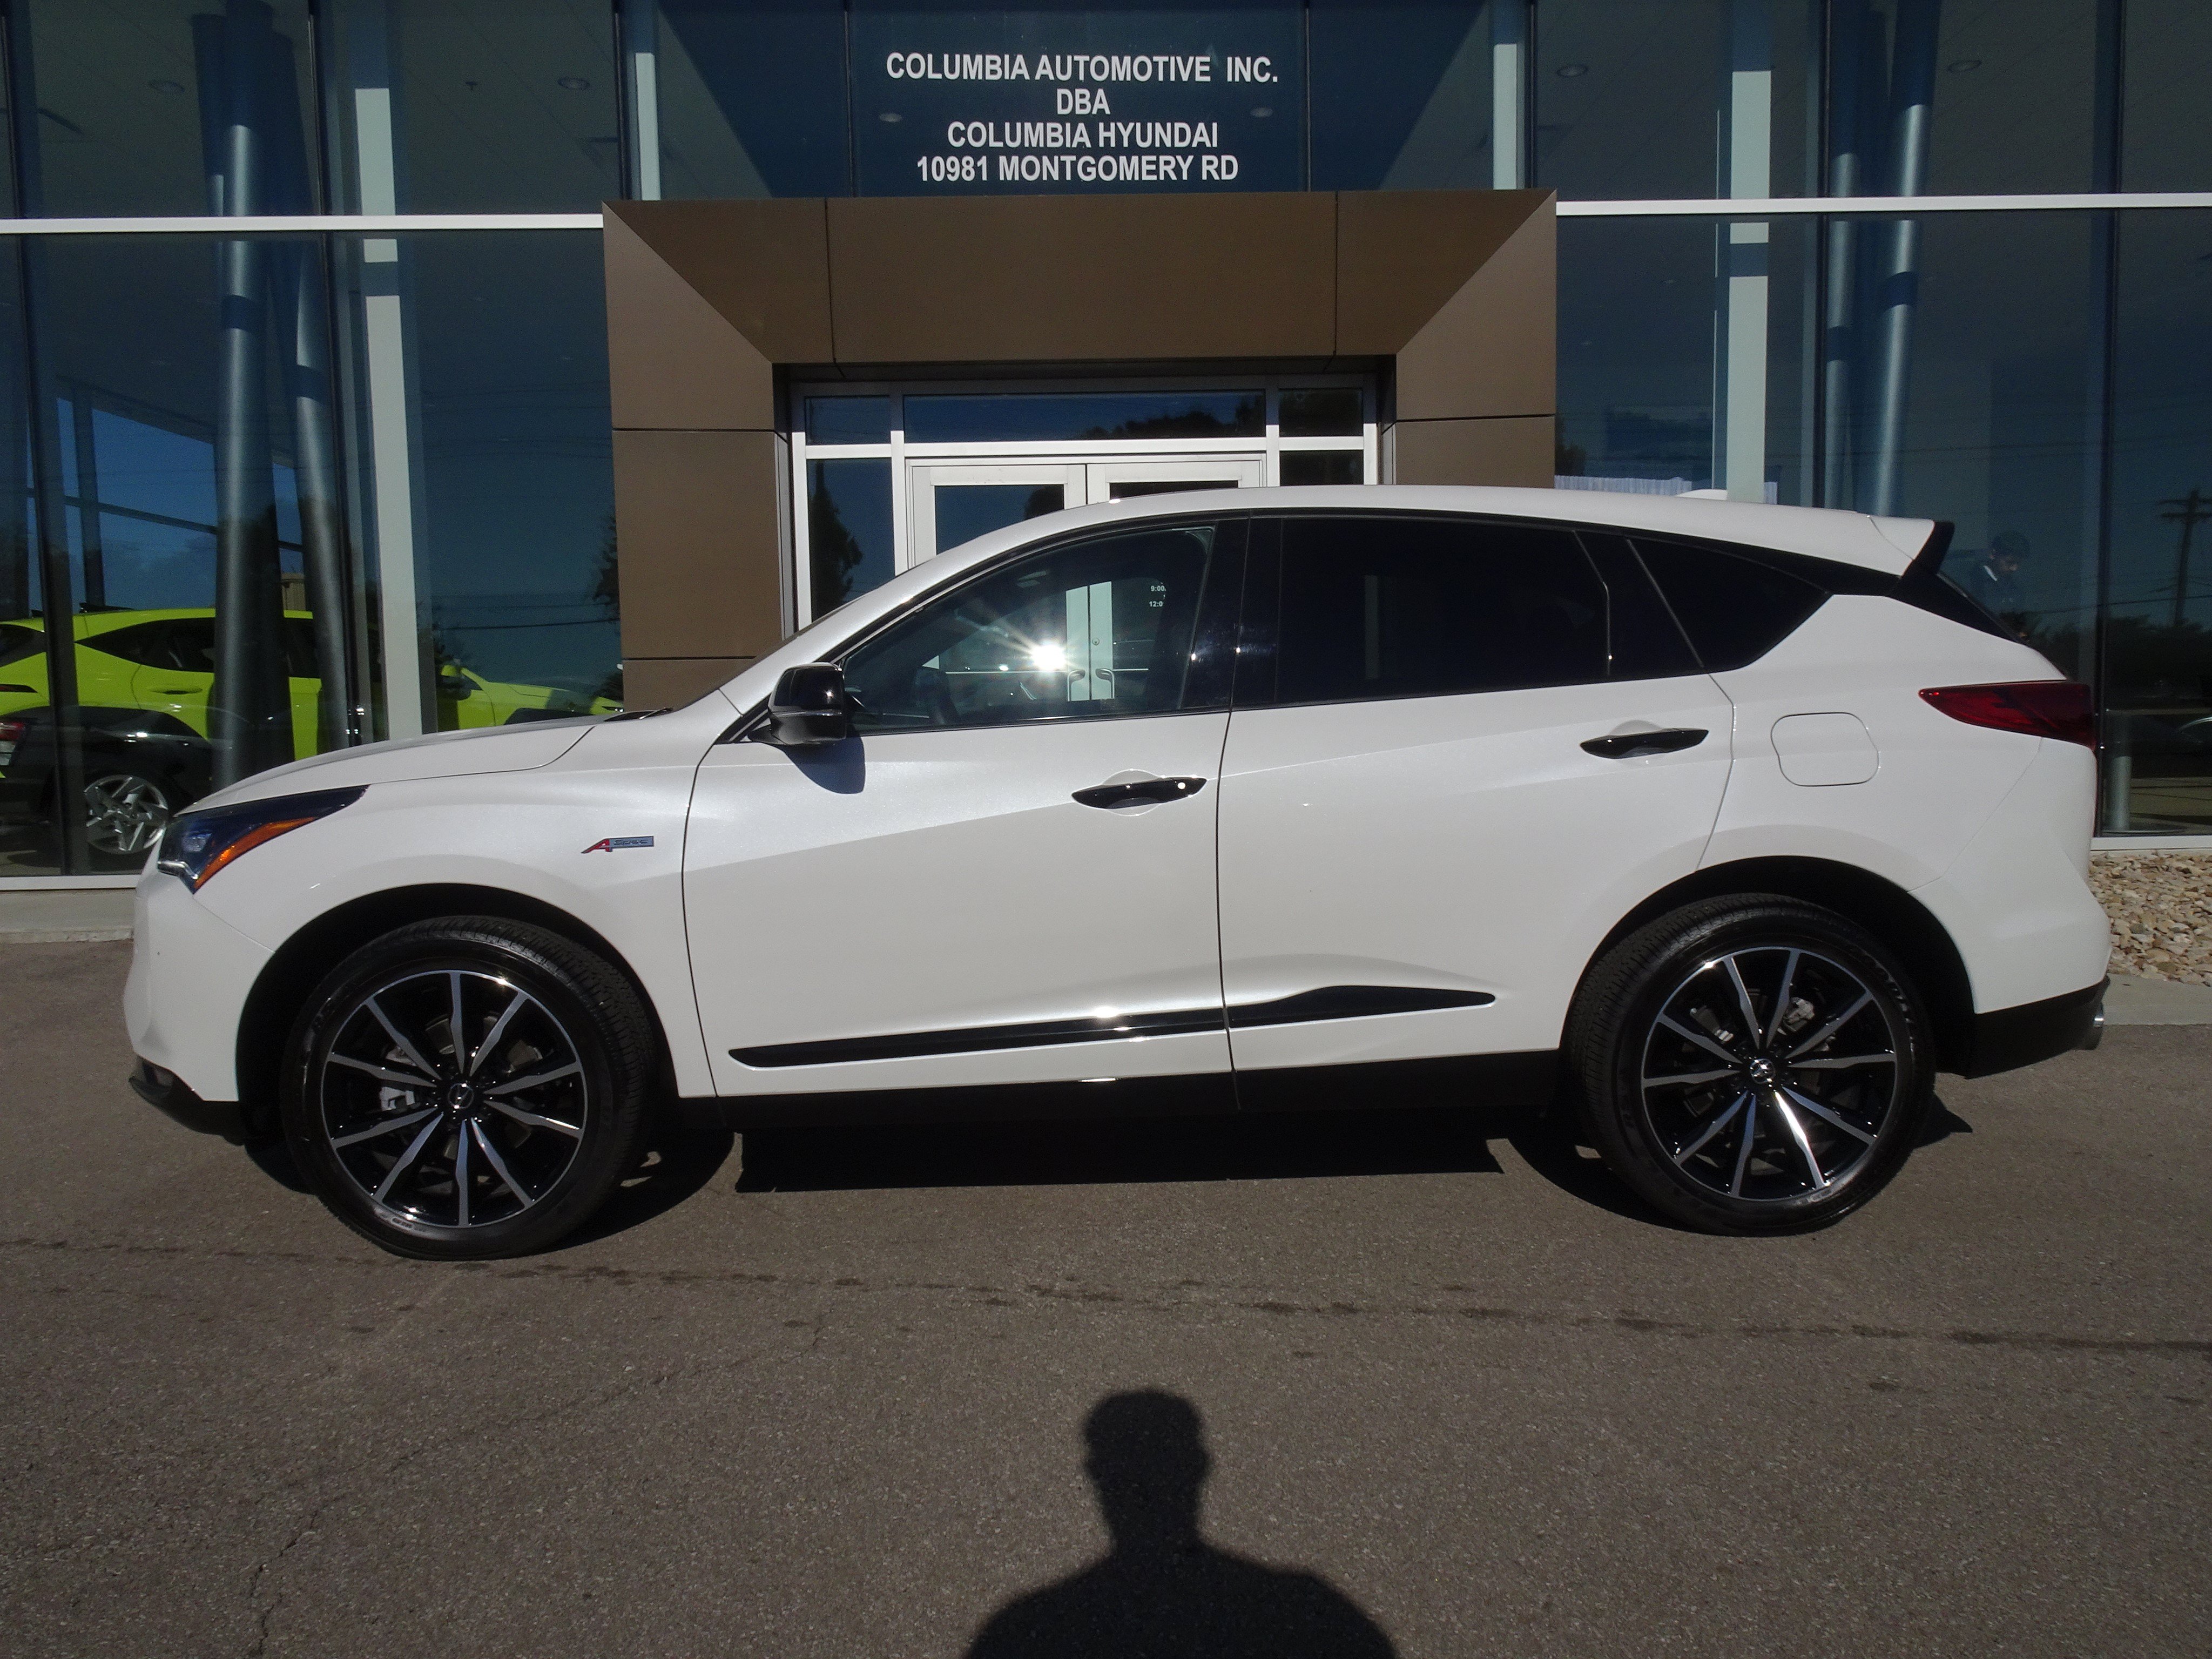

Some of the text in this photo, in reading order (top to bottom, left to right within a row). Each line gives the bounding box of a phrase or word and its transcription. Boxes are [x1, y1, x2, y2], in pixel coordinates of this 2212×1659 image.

[886, 52, 1278, 82] COLUMBIA AUTOMOTIVE INC.
[1057, 89, 1110, 114] DBA
[947, 122, 1218, 147] COLUMBIA HYUNDAI
[917, 155, 1238, 181] 10981 MONTGOMERY RD
